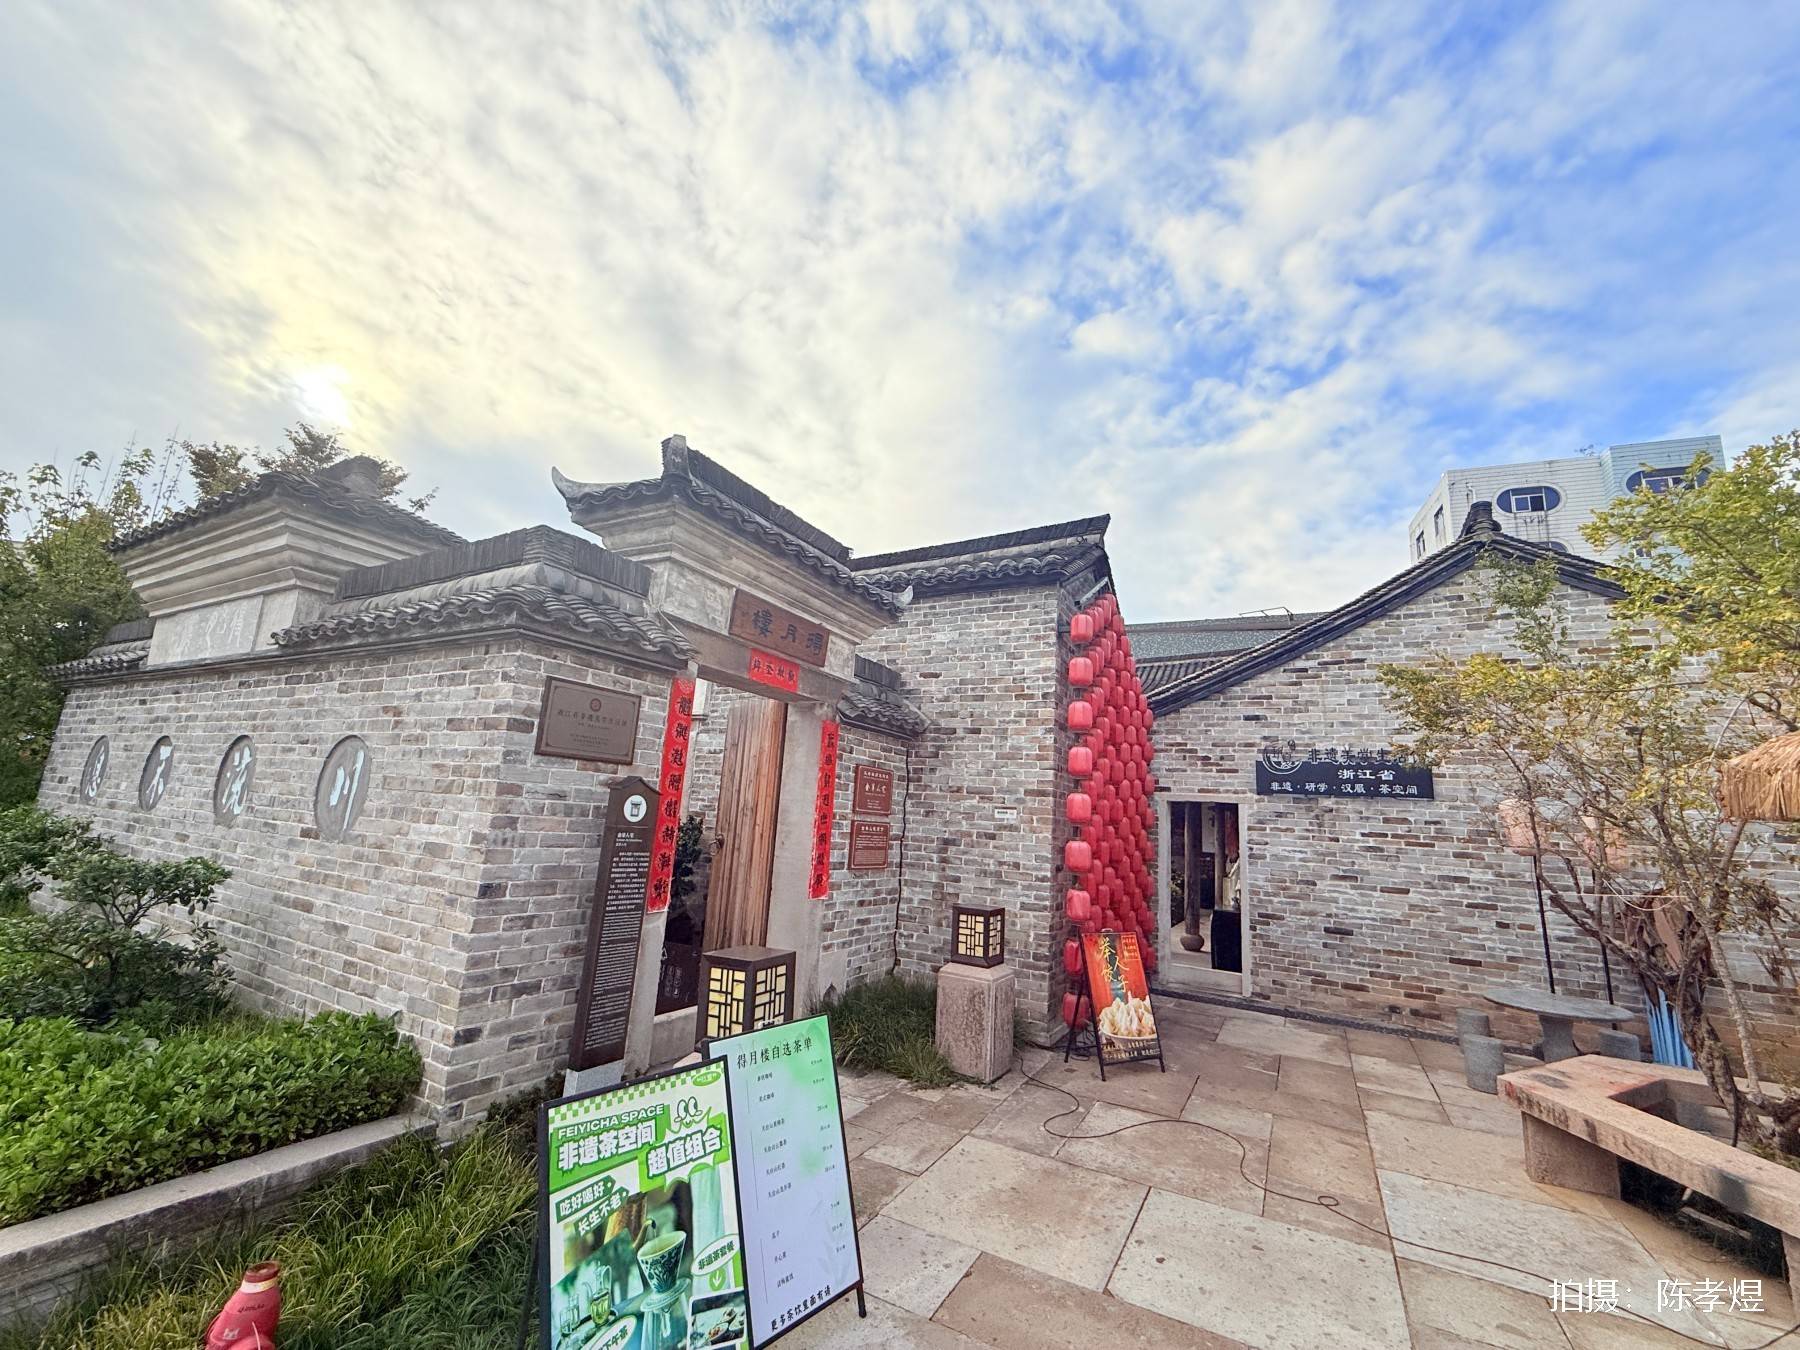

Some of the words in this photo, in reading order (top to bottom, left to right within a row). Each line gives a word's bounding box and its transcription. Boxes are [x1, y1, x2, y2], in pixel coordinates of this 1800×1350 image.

[1308, 746, 1418, 765] 非遗美学生
[1338, 769, 1396, 781] 浙江省
[737, 1037, 813, 1069] 得月楼自选茶单
[558, 1116, 618, 1140] FEIYICHA
[621, 1104, 665, 1123] SPACE
[557, 1119, 656, 1171] 非遗茶空间
[648, 1127, 722, 1177] 超值组合
[560, 1181, 605, 1217] 吃好喝好
[579, 1193, 621, 1236] 长生不老
[598, 1325, 628, 1350] 下午茶
